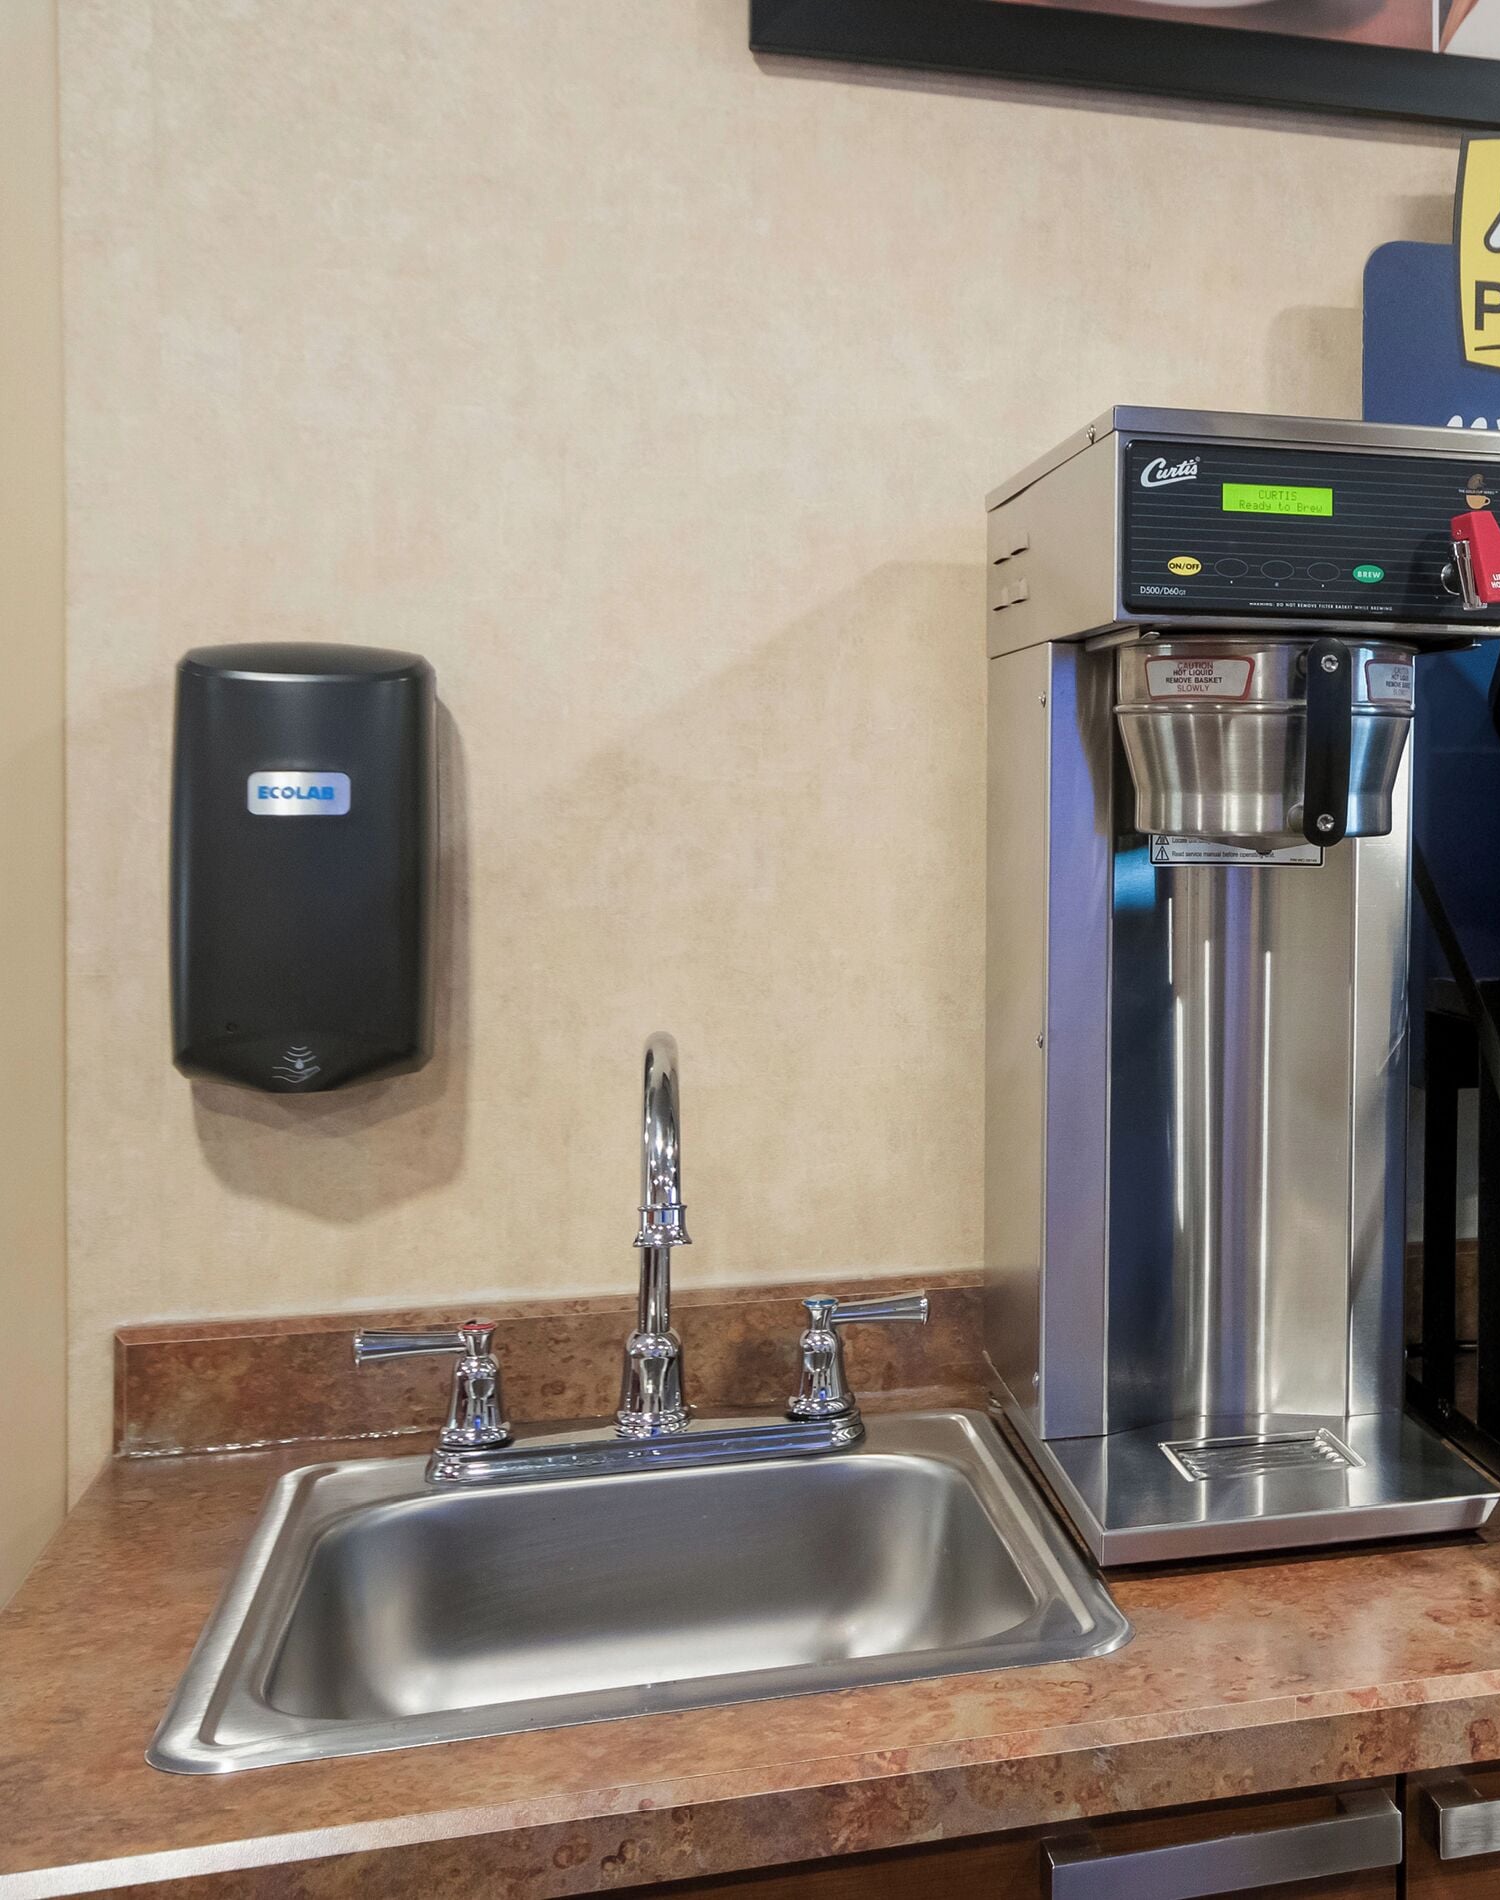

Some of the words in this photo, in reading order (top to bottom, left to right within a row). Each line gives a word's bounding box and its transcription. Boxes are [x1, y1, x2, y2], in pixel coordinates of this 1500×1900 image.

[1258, 489, 1297, 501] CURTIS
[1239, 500, 1272, 511] Ready
[1278, 501, 1290, 512] to
[1296, 502, 1323, 513] Brew
[1168, 562, 1200, 571] ON/OFF
[1357, 571, 1381, 579] BREW
[1177, 661, 1214, 669] CAUTION
[1165, 676, 1193, 684] REMOVE
[1194, 676, 1222, 684] BASKET
[1177, 684, 1210, 692] SLOWLY
[257, 786, 335, 799] ECOLAB
